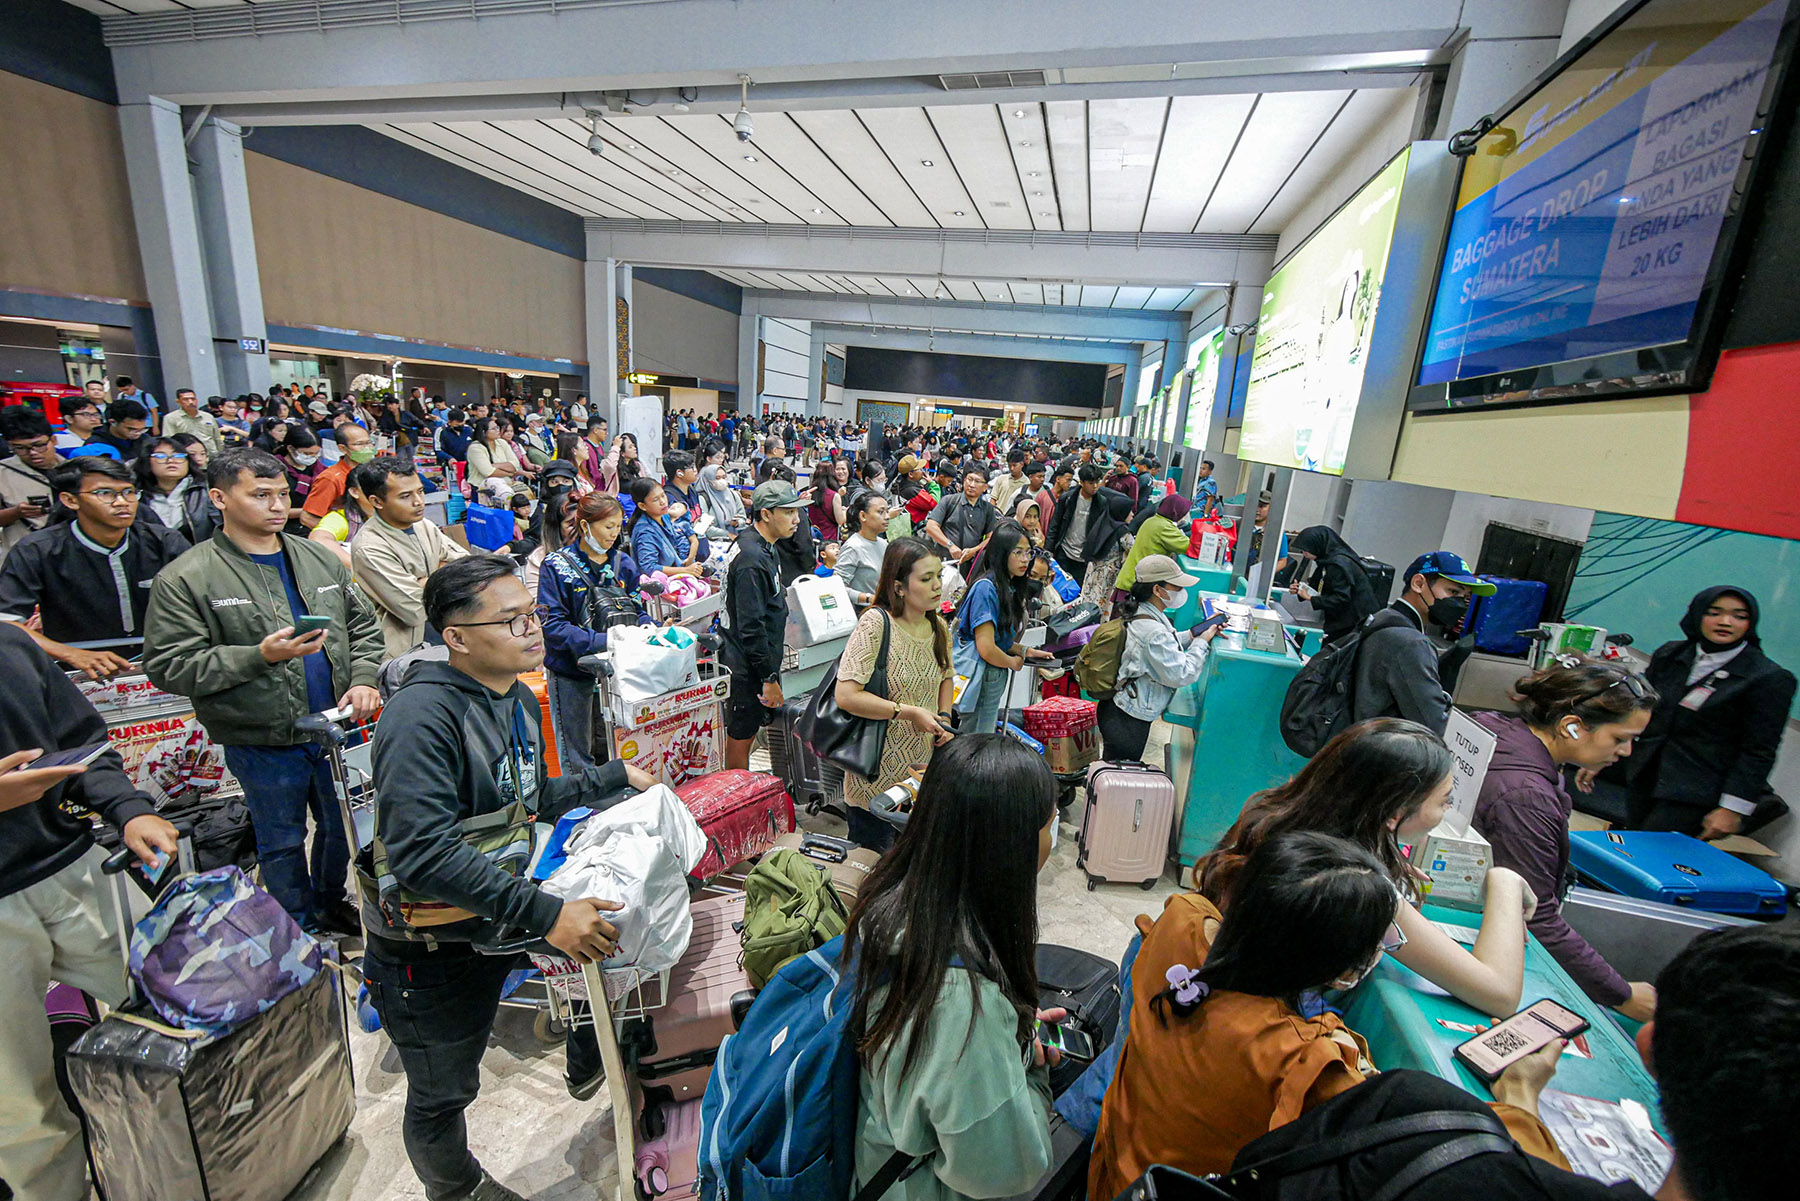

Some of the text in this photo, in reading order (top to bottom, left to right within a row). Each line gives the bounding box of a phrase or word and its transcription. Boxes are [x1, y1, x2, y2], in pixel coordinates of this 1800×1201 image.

[1652, 116, 1729, 174] BAGASI
[1625, 148, 1738, 216] ANDA YANG
[1451, 169, 1608, 274] BAGGAGE DROP
[1617, 190, 1725, 250] LEBIH DARI
[1460, 237, 1560, 305] SUMATERA
[1630, 241, 1684, 277] 20 KG
[674, 684, 713, 704] KURNIA
[1456, 731, 1480, 757] TUTUP
